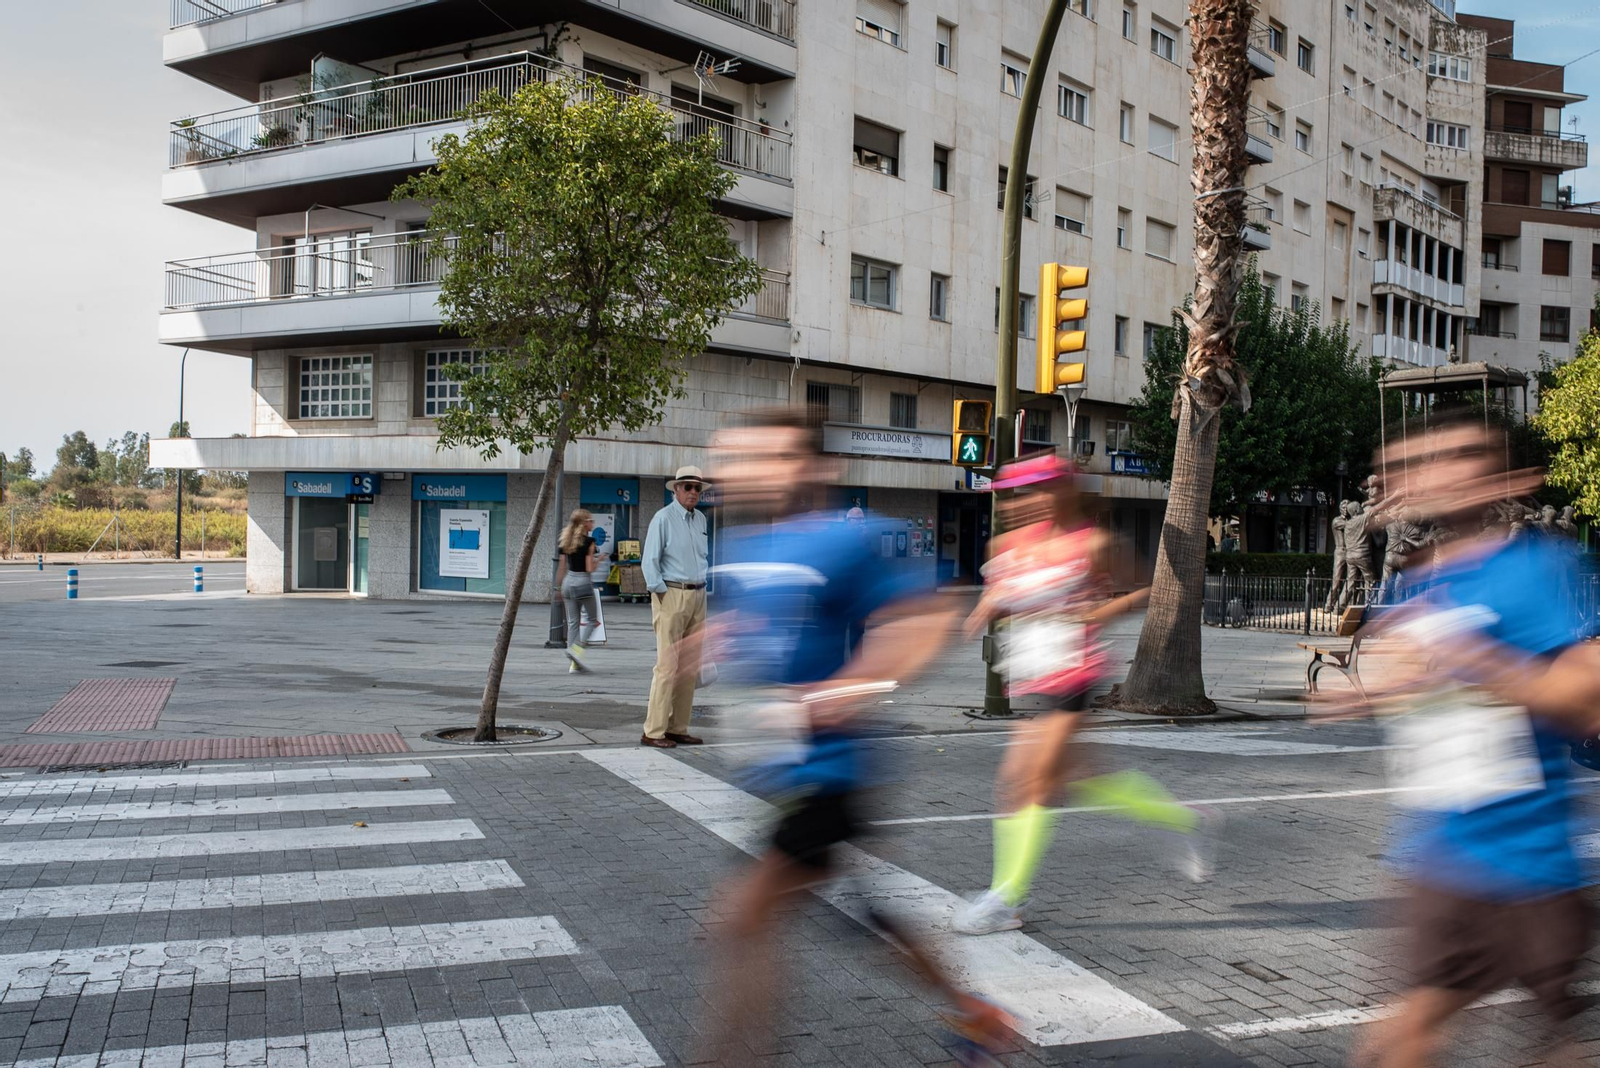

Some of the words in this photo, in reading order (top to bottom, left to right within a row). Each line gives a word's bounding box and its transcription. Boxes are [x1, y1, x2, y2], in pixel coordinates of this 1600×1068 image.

[851, 430, 911, 444] PROCURADORAS
[297, 481, 332, 494] Sabadell
[362, 477, 372, 493] S
[426, 484, 466, 497] Sabadell
[623, 490, 630, 501] S
